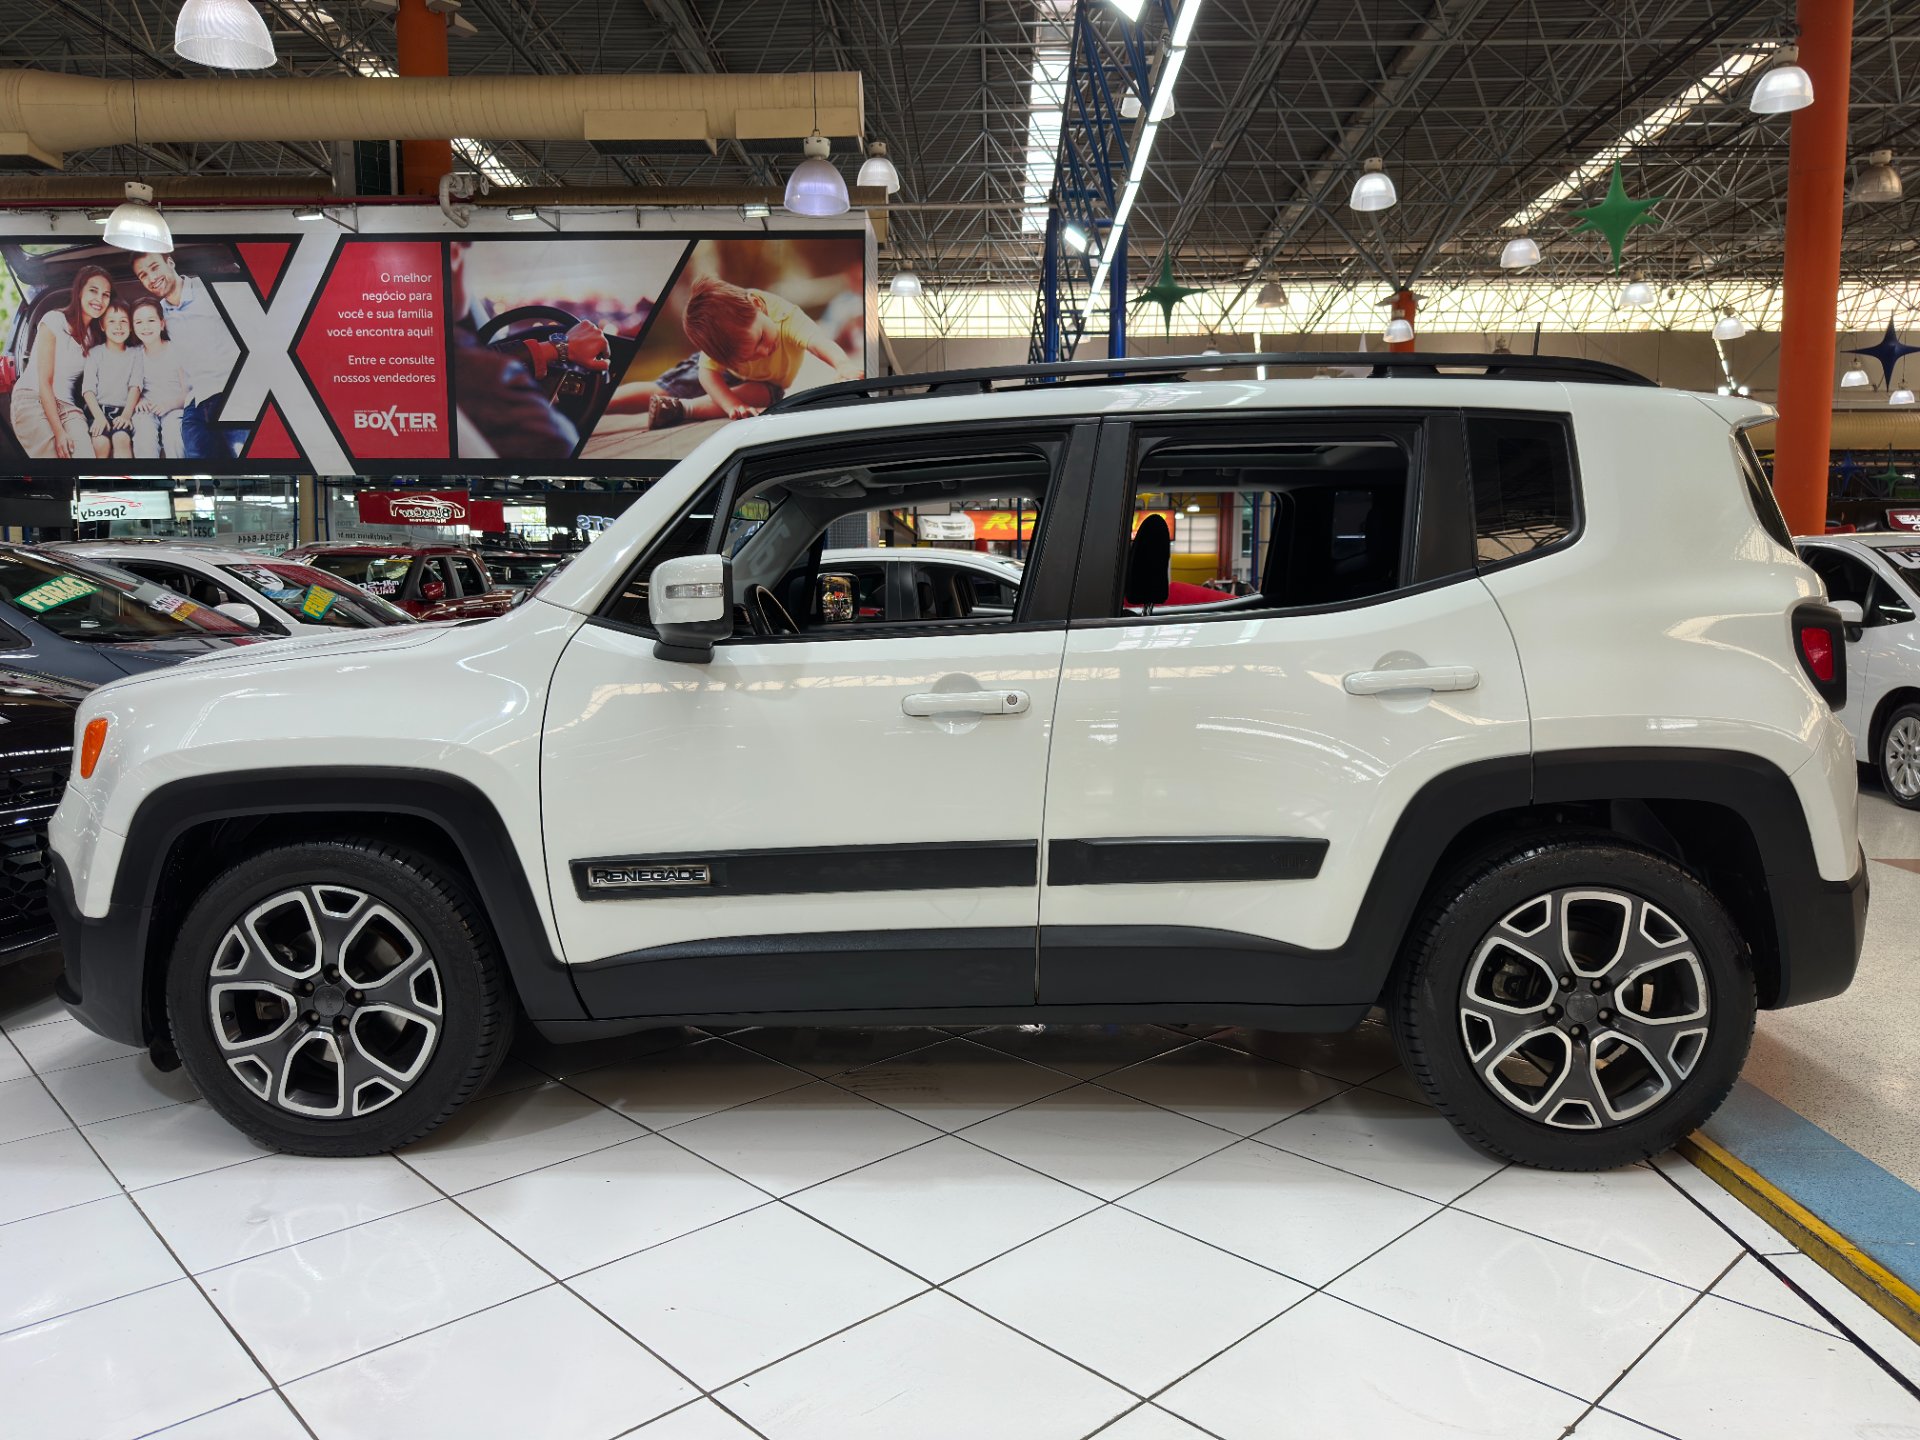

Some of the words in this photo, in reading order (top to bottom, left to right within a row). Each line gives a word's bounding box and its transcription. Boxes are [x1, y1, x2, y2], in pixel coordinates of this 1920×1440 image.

[380, 272, 391, 283] O
[393, 272, 433, 283] melhor
[362, 290, 406, 304] negócio
[408, 292, 433, 303] para
[338, 308, 365, 319] você
[367, 310, 374, 319] e
[376, 310, 395, 319] sua
[397, 308, 433, 319] família
[326, 326, 353, 337] você
[355, 327, 405, 337] encontra
[407, 326, 434, 338] aqui!
[347, 354, 377, 365] Entre
[379, 356, 386, 365] e
[388, 354, 435, 365] consulte
[333, 373, 371, 383] nossos
[373, 372, 436, 383] vendedores
[353, 404, 438, 437] BOXTER
[591, 867, 708, 884] RENEGADE
